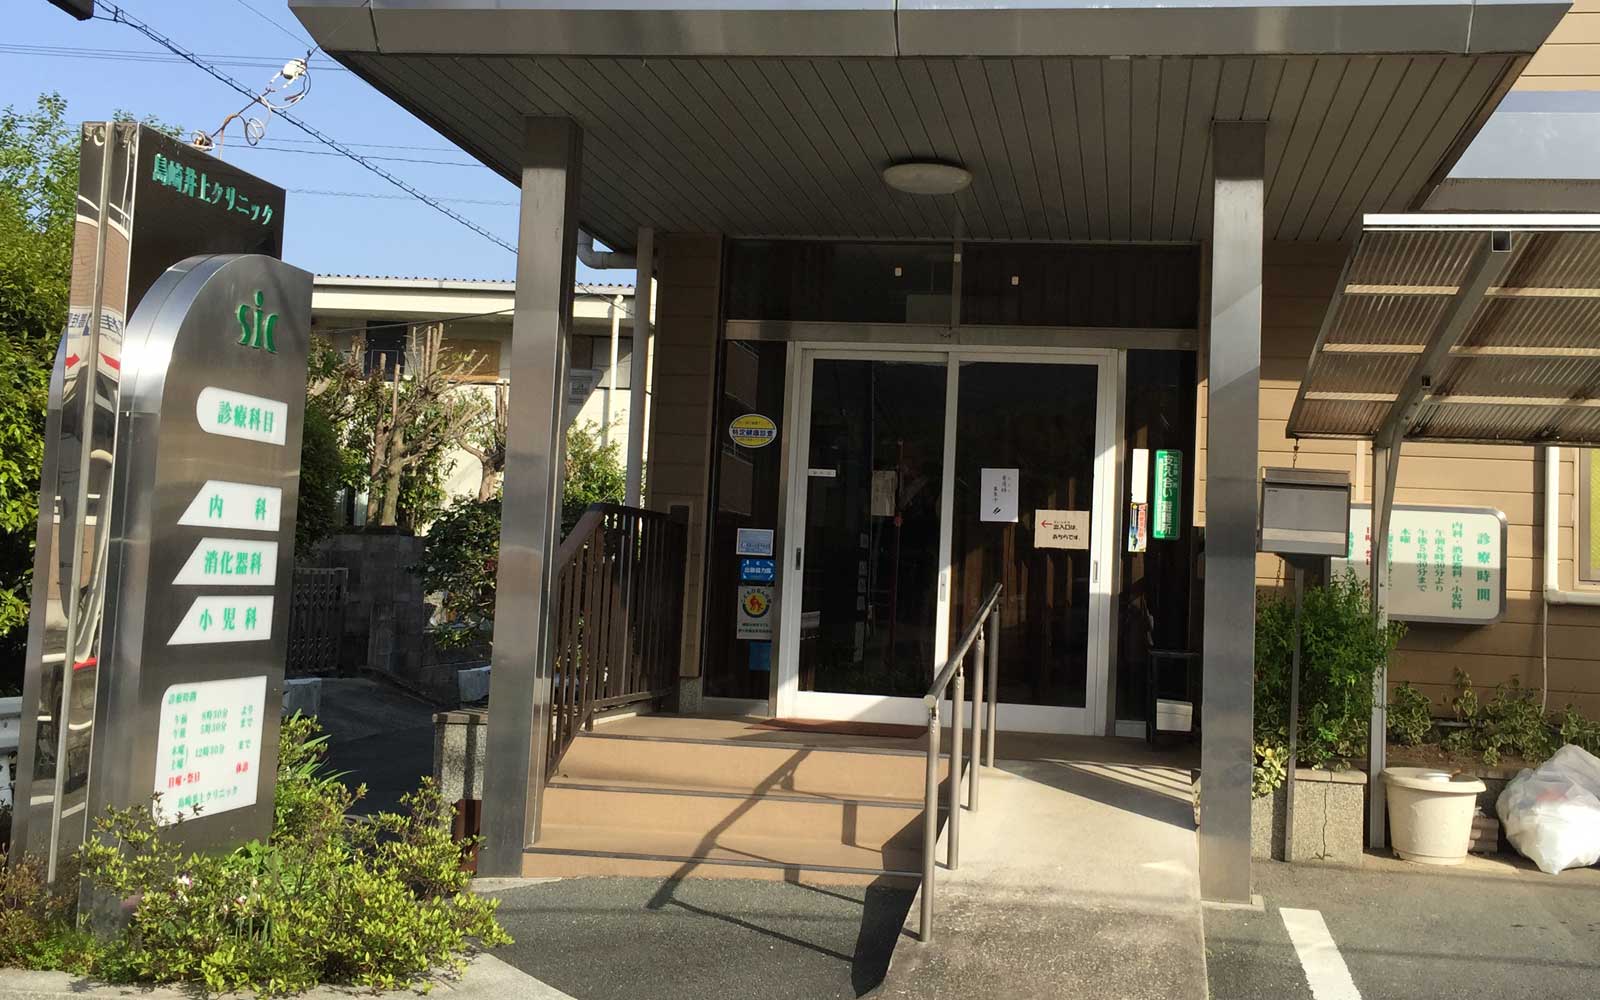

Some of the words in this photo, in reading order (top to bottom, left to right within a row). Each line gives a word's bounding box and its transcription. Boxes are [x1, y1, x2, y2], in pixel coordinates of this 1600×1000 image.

[217, 400, 274, 433] 診療科目
[209, 494, 267, 520] 内科
[204, 550, 262, 575] 消化器科
[1477, 532, 1491, 602] 診療時間
[199, 607, 257, 631] 小児科
[168, 691, 197, 705] 診療時間
